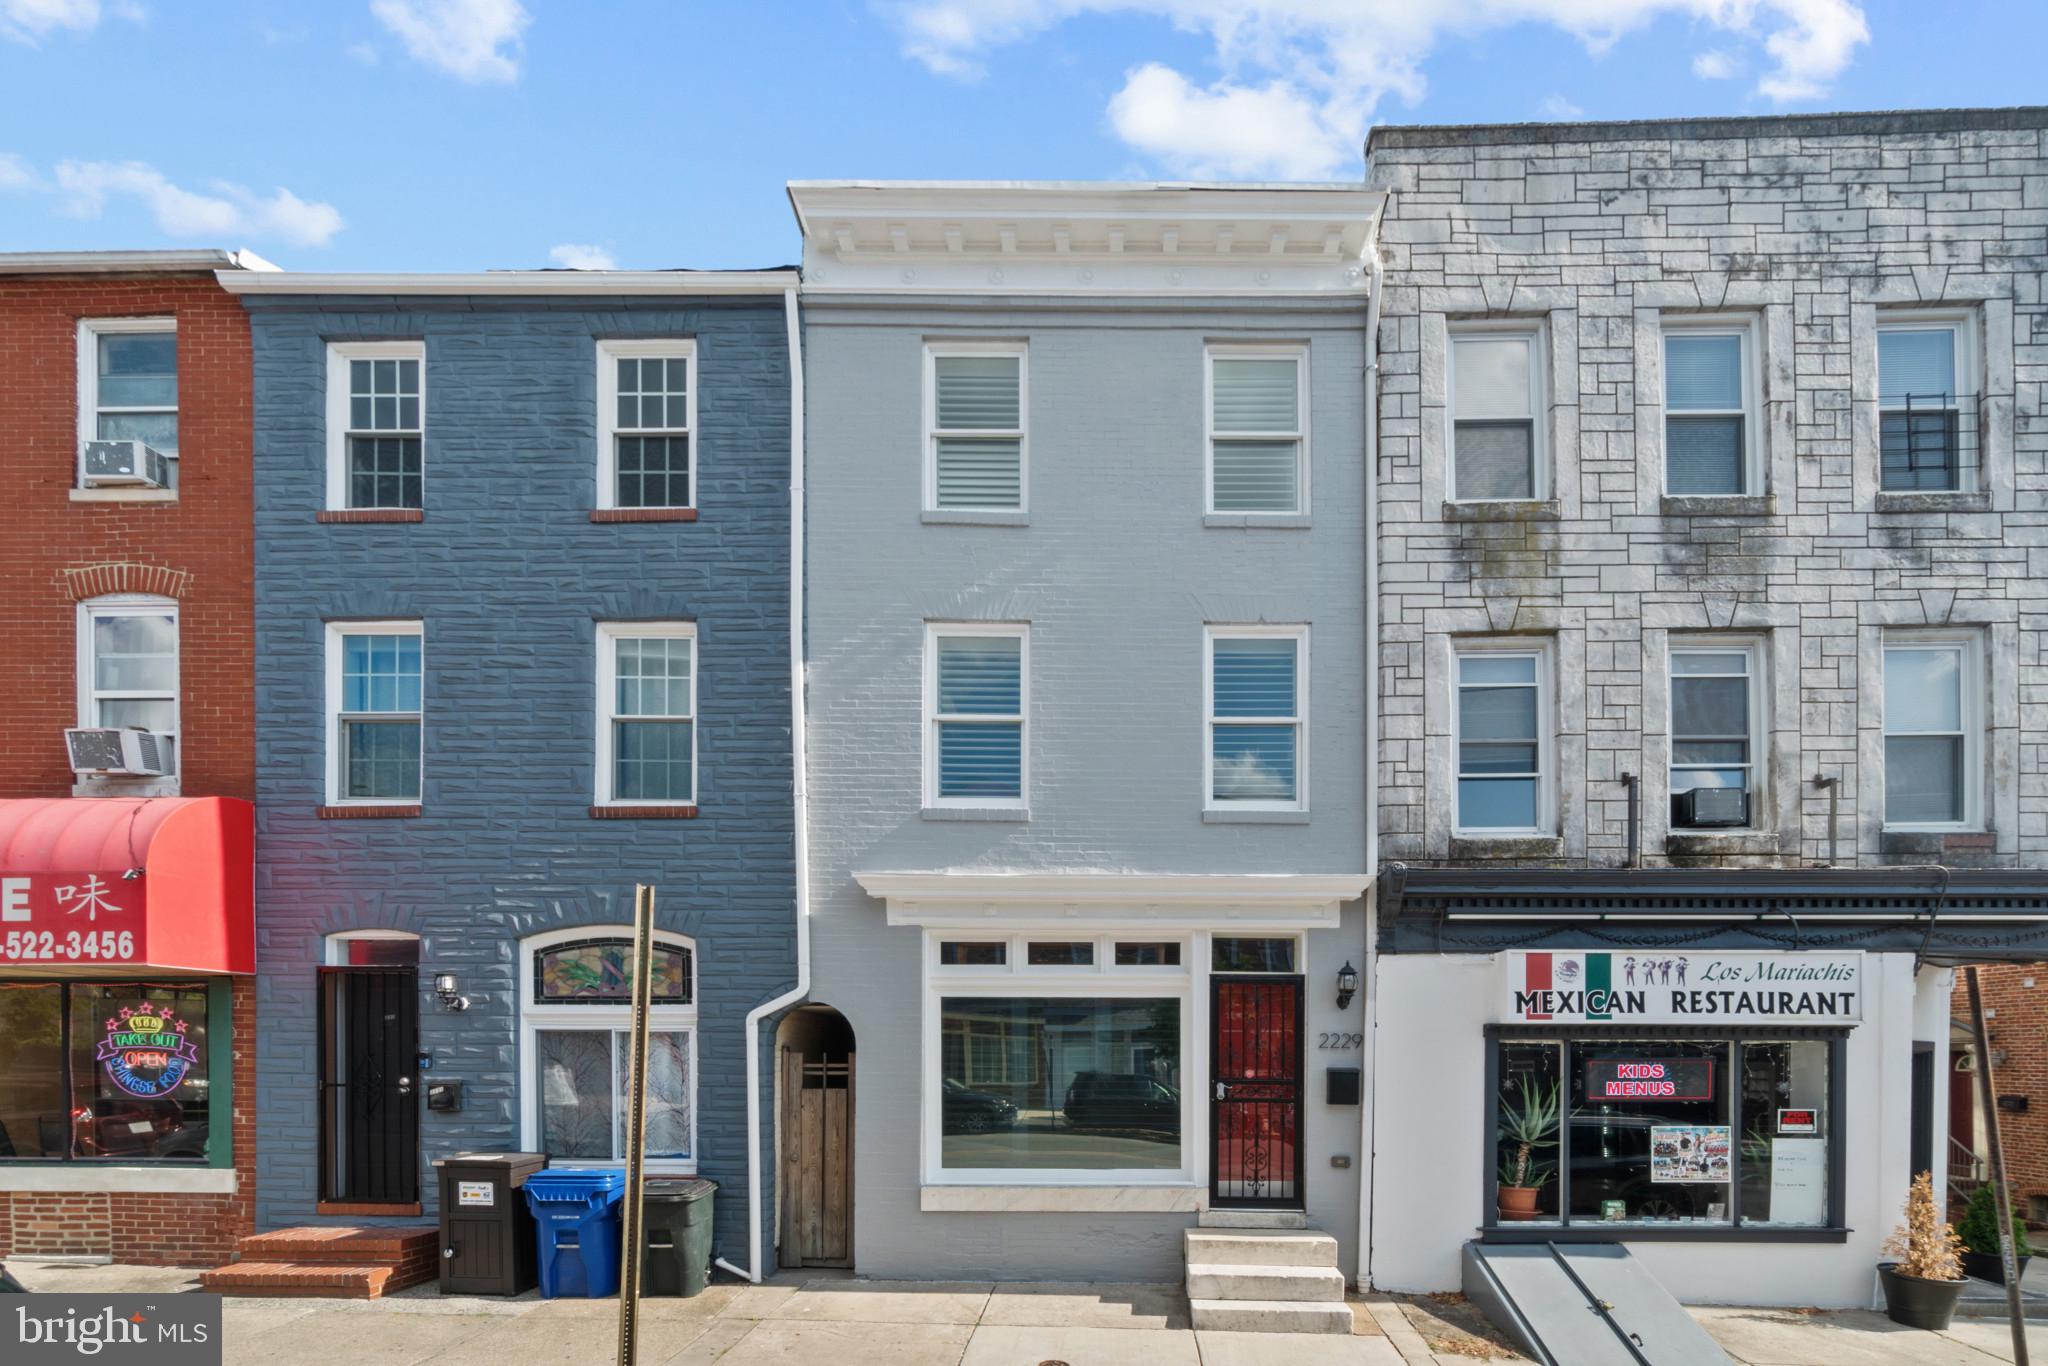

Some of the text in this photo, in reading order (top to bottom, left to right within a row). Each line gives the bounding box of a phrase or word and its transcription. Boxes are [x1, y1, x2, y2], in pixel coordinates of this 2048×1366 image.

[54, 873, 123, 921] 味
[1700, 961, 1855, 983] Los Mariachis
[1515, 990, 1856, 1016] MEXICAN RESTAURANT
[112, 1032, 179, 1047] TAKE OUT
[1319, 1032, 1363, 1049] 2229
[124, 1051, 168, 1067] OPEN
[110, 1056, 185, 1094] CHINESE FOOD
[1617, 1064, 1665, 1079] KIDS
[1606, 1081, 1675, 1096] MENUS
